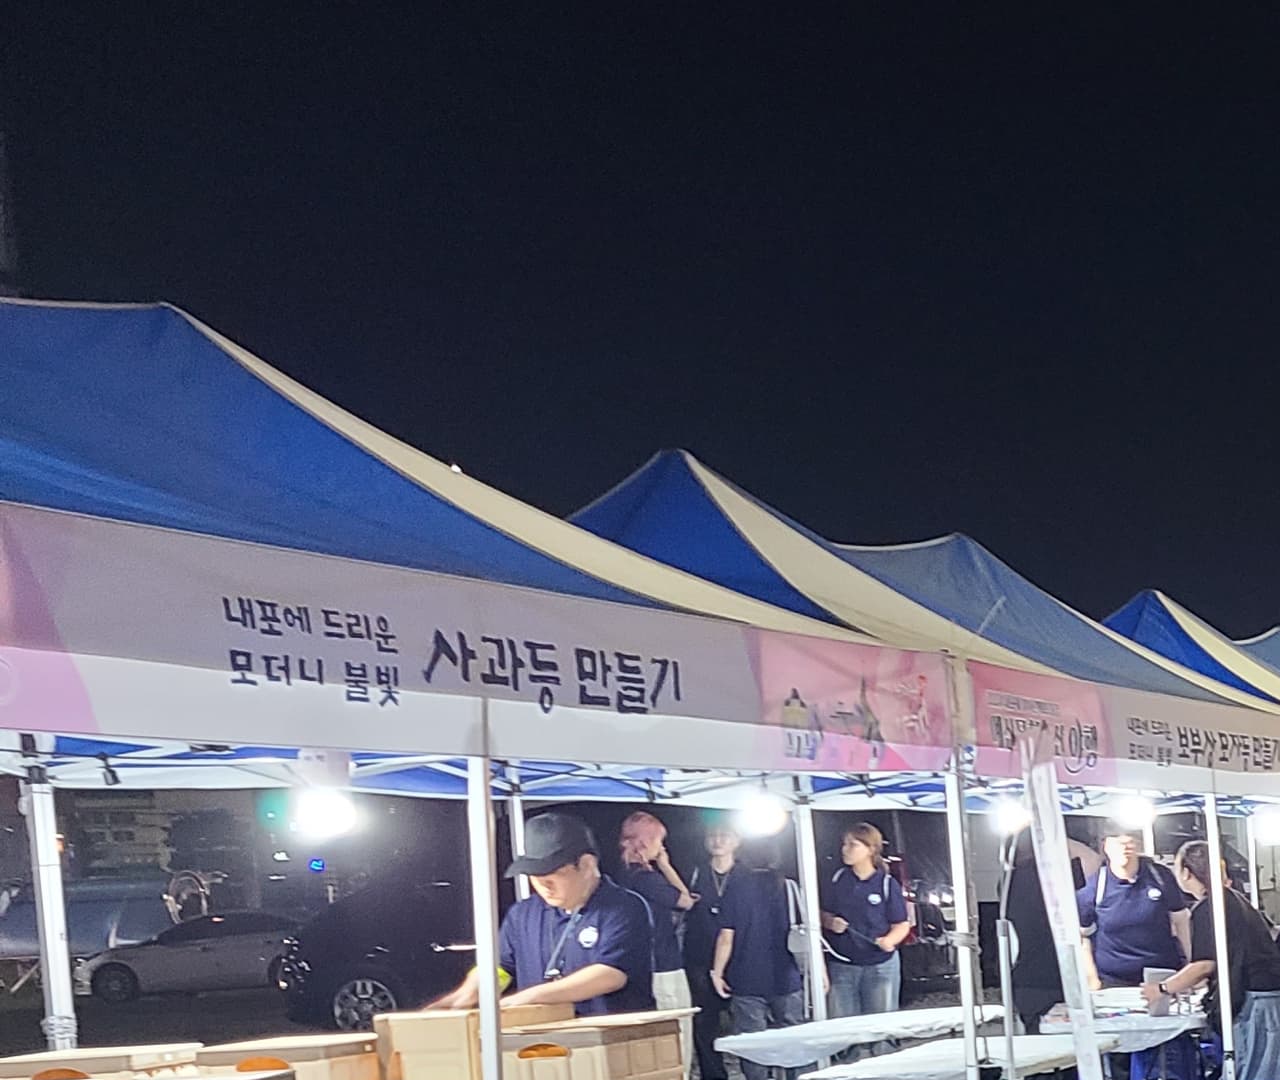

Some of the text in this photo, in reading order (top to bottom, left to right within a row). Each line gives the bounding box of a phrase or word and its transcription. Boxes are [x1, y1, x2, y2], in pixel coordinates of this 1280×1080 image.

[221, 596, 398, 654] 내포에 드리운
[229, 648, 400, 708] 모더니 불빛
[423, 628, 682, 715] 사과등 만들기
[1176, 725, 1217, 769] 보부상
